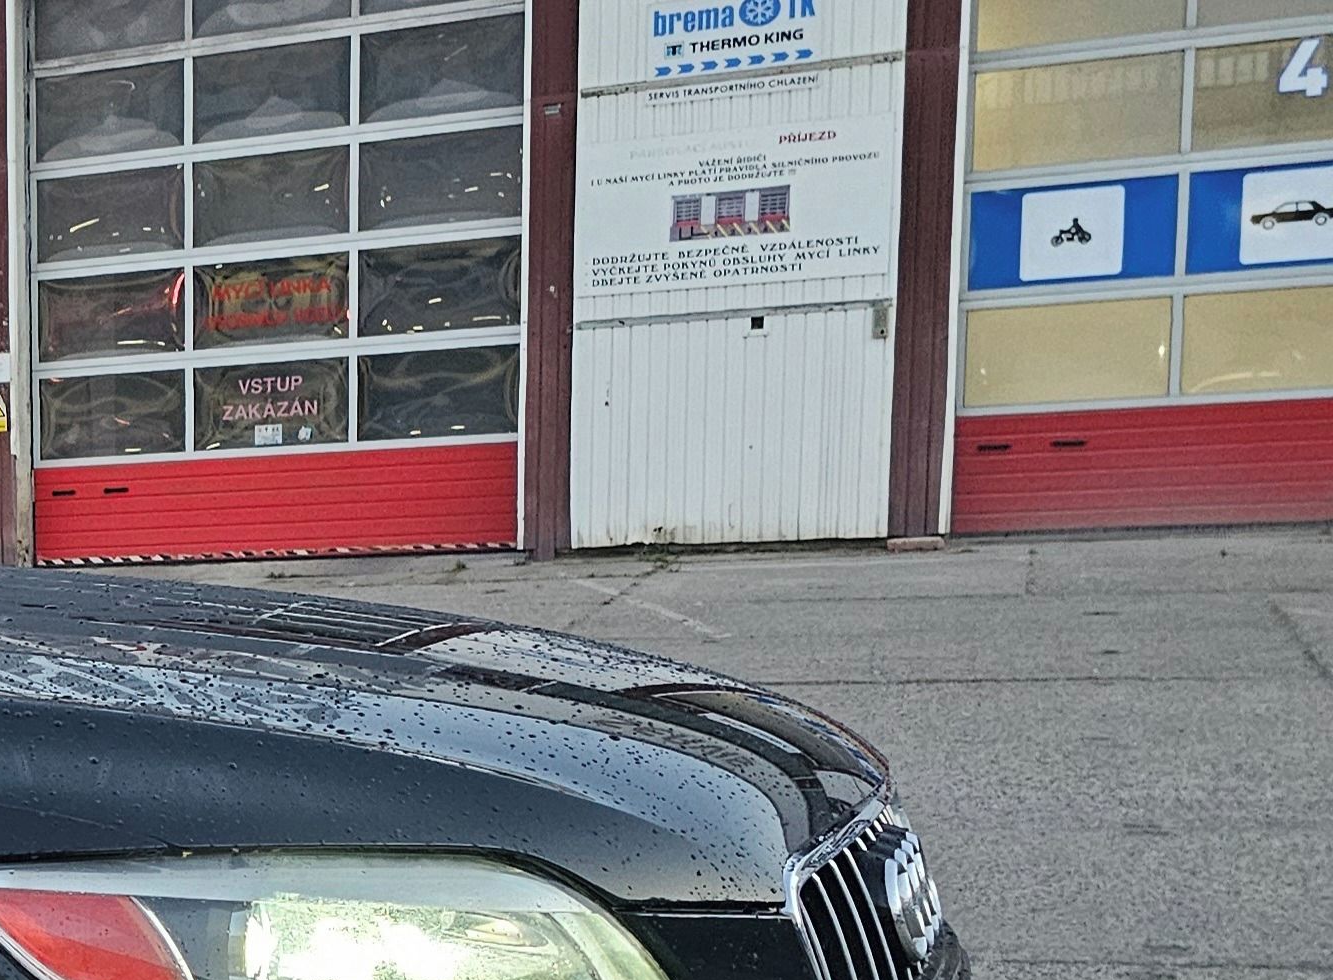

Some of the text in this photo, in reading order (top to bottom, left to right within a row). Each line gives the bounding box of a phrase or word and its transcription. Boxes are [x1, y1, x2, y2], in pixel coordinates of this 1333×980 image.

[653, 5, 735, 37] brema
[689, 34, 760, 54] THERMO
[764, 28, 804, 44] KING
[1278, 37, 1328, 97] 4
[648, 89, 679, 101] SERVIS
[683, 81, 765, 97] TRANSPORTNÍHO
[778, 130, 837, 144] PŘÍJEZD
[591, 263, 659, 277] VYČKEJTE
[795, 248, 830, 261] MYCÍ
[839, 245, 880, 257] LINKY
[592, 252, 669, 266] DODRŽUJTE
[592, 276, 641, 288] DBEJTE
[713, 263, 802, 278] OPATRNOSTI
[238, 375, 303, 395] VSTUP
[222, 396, 318, 420] ZAKÁZÁN
